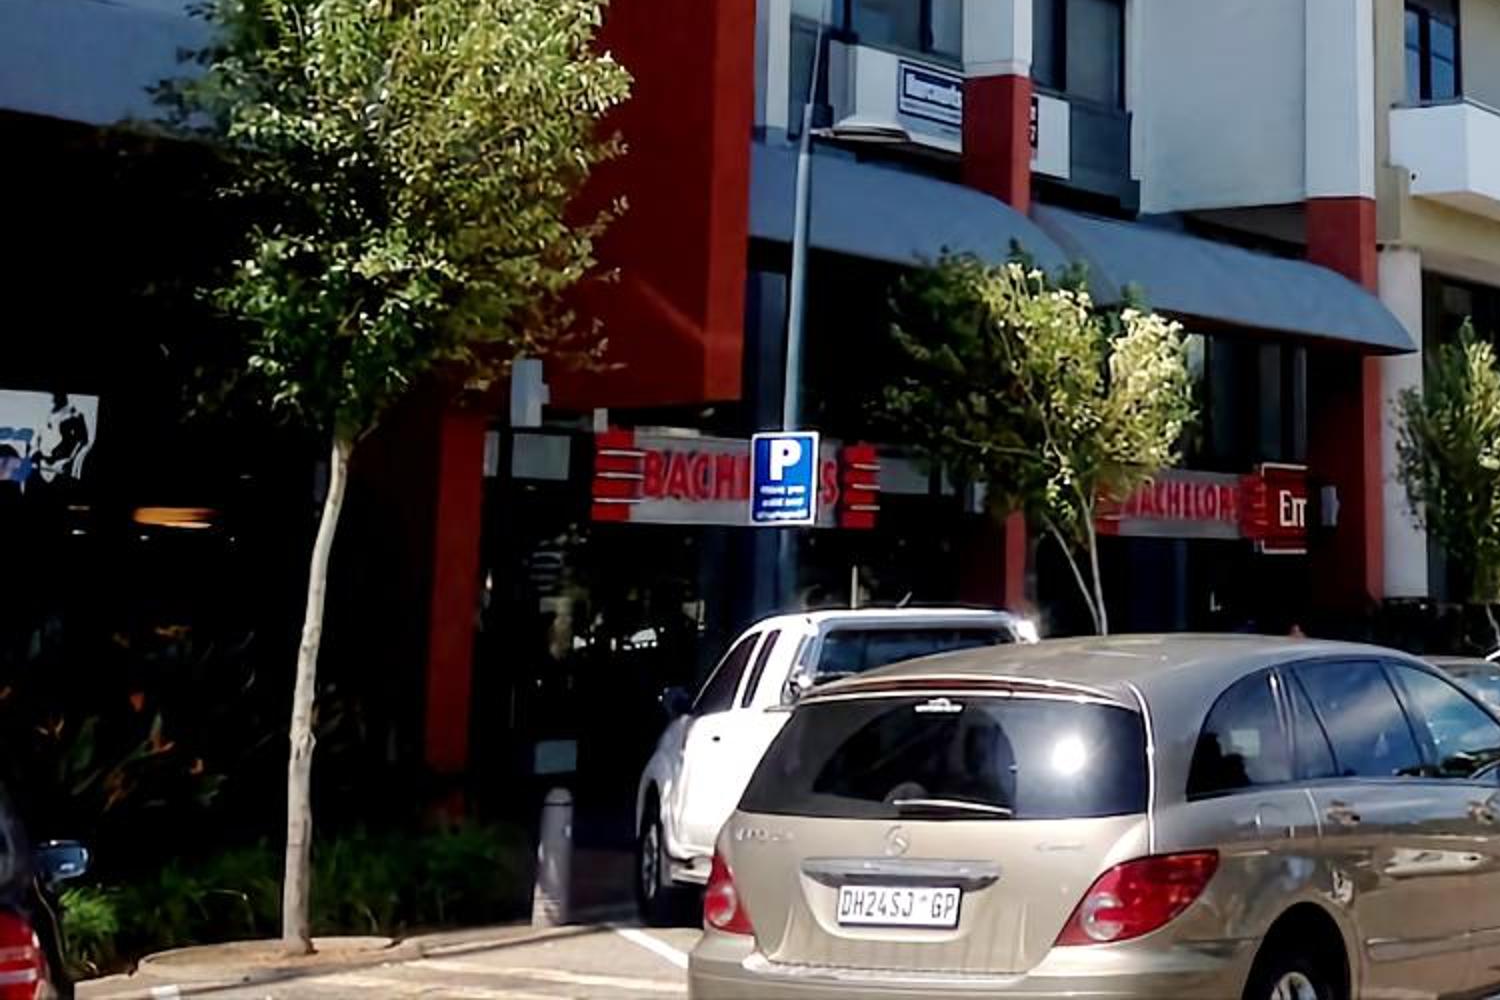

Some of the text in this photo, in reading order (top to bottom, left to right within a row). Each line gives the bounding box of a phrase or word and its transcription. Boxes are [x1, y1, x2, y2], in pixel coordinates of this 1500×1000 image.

[643, 449, 839, 506] BACHS
[769, 439, 802, 481] P
[840, 890, 956, 919] DH24SJ GP
